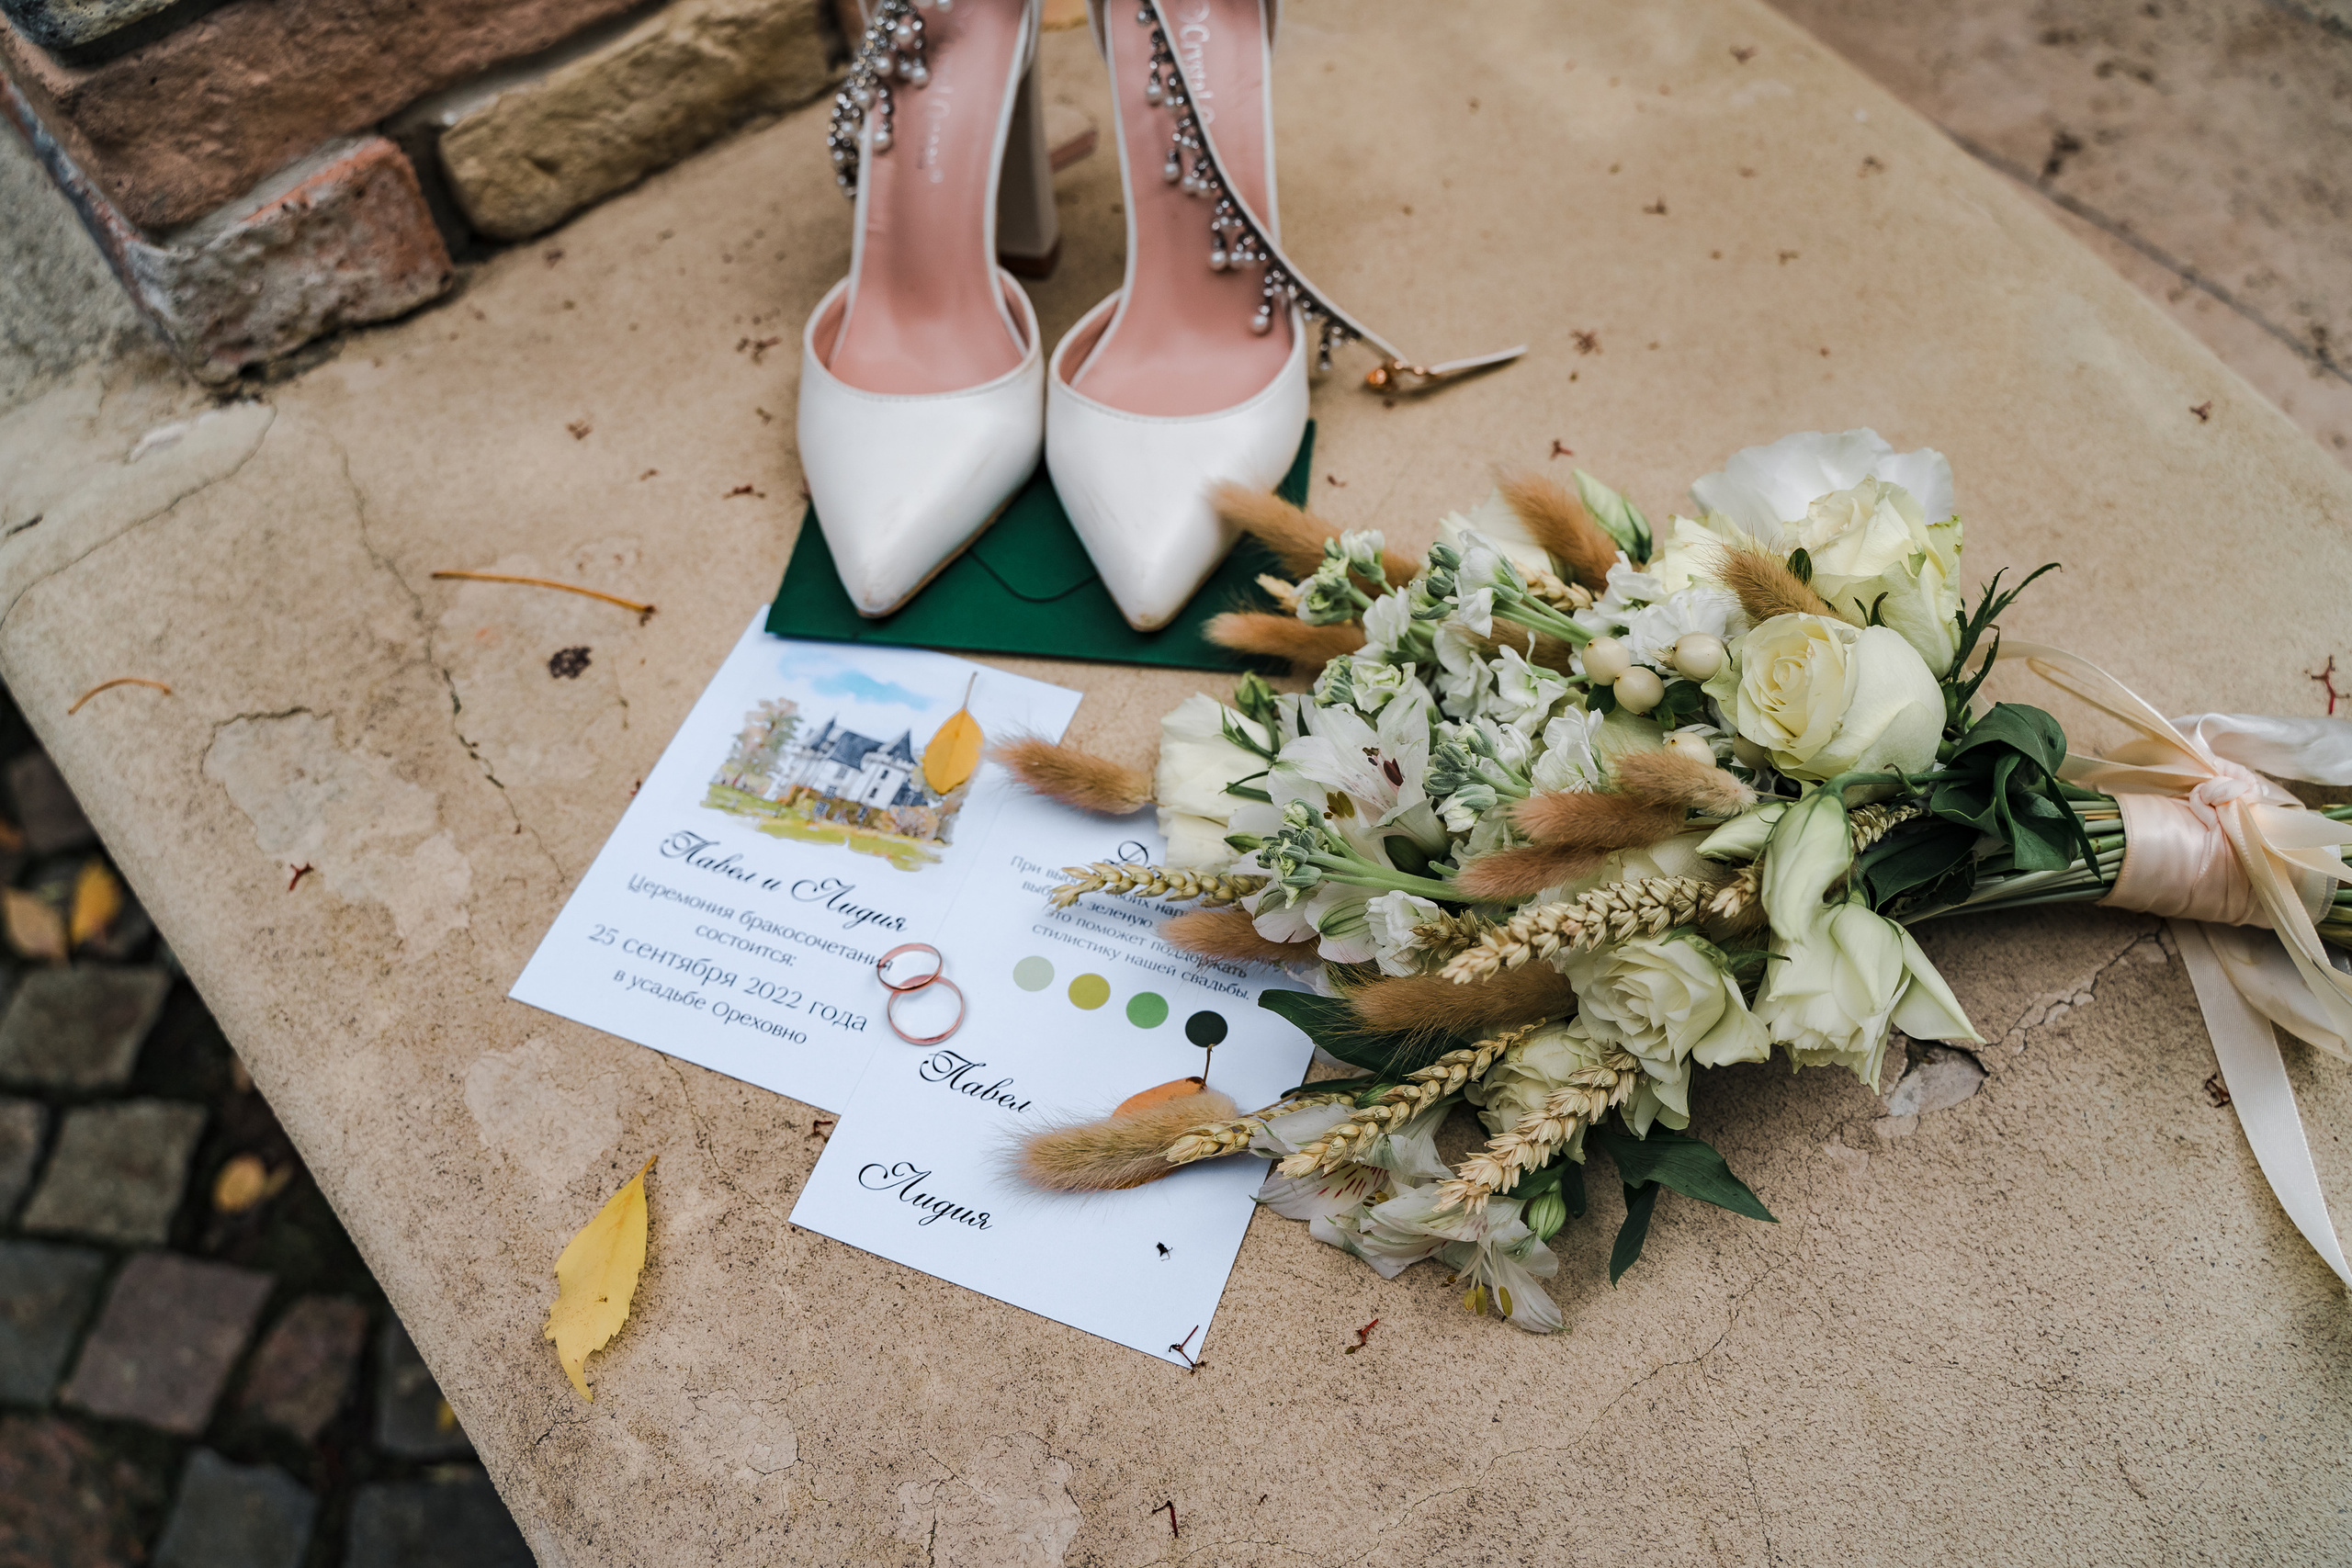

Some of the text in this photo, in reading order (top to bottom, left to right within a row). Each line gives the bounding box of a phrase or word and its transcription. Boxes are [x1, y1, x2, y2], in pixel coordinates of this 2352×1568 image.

[628, 873, 735, 919] Церемония
[659, 829, 908, 931] Павел и Лидия
[1011, 855, 1042, 874] При
[695, 924, 797, 966] состоится:
[1076, 918, 1147, 947] поможет
[1087, 901, 1153, 928] зеленую
[588, 923, 867, 1032] 25 сентября 2022 года
[1032, 923, 1250, 1000] стилистику нашей свадьбы.
[613, 969, 807, 1044] в усадьбе Ореховно
[919, 1049, 1033, 1114] Павел
[858, 1161, 993, 1231] Лидия
